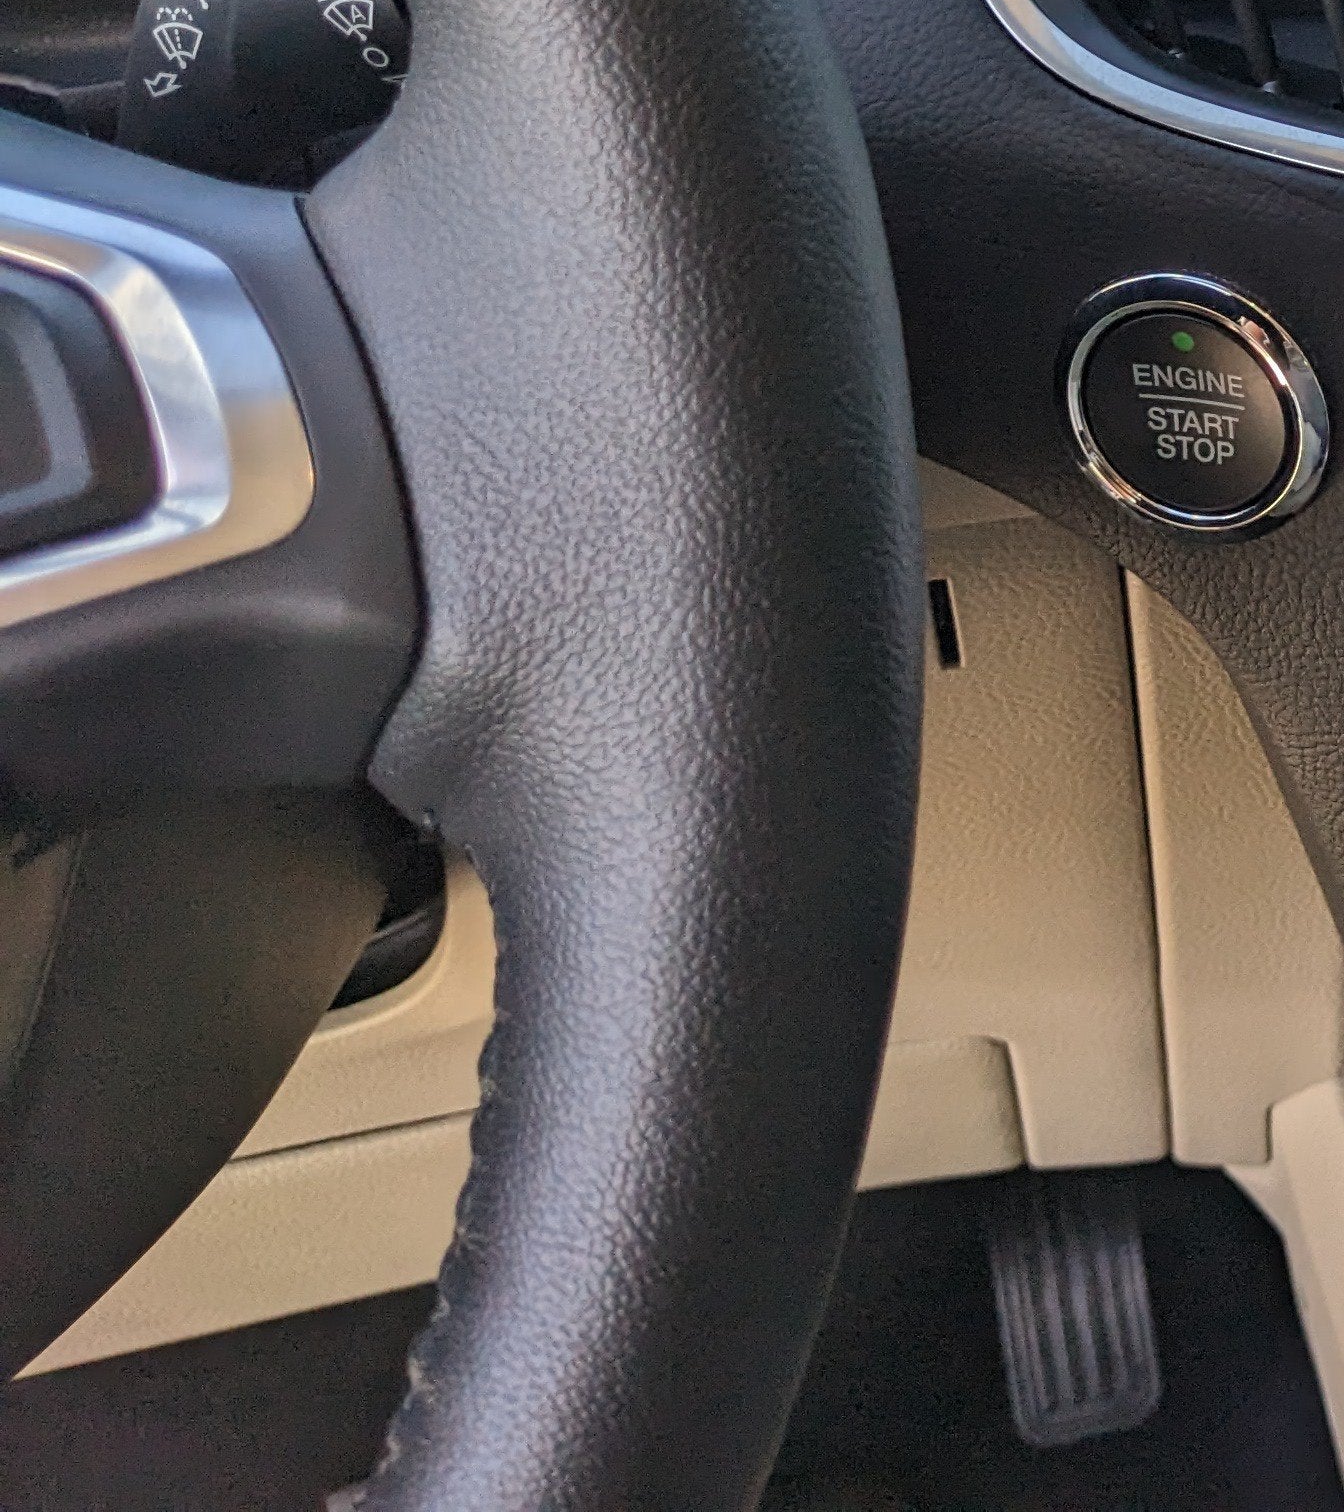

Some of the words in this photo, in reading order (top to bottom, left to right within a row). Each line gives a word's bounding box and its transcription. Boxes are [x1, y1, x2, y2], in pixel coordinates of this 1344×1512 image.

[1132, 363, 1246, 399] ENGINE
[1147, 406, 1240, 440] START
[1157, 433, 1235, 466] STOP
